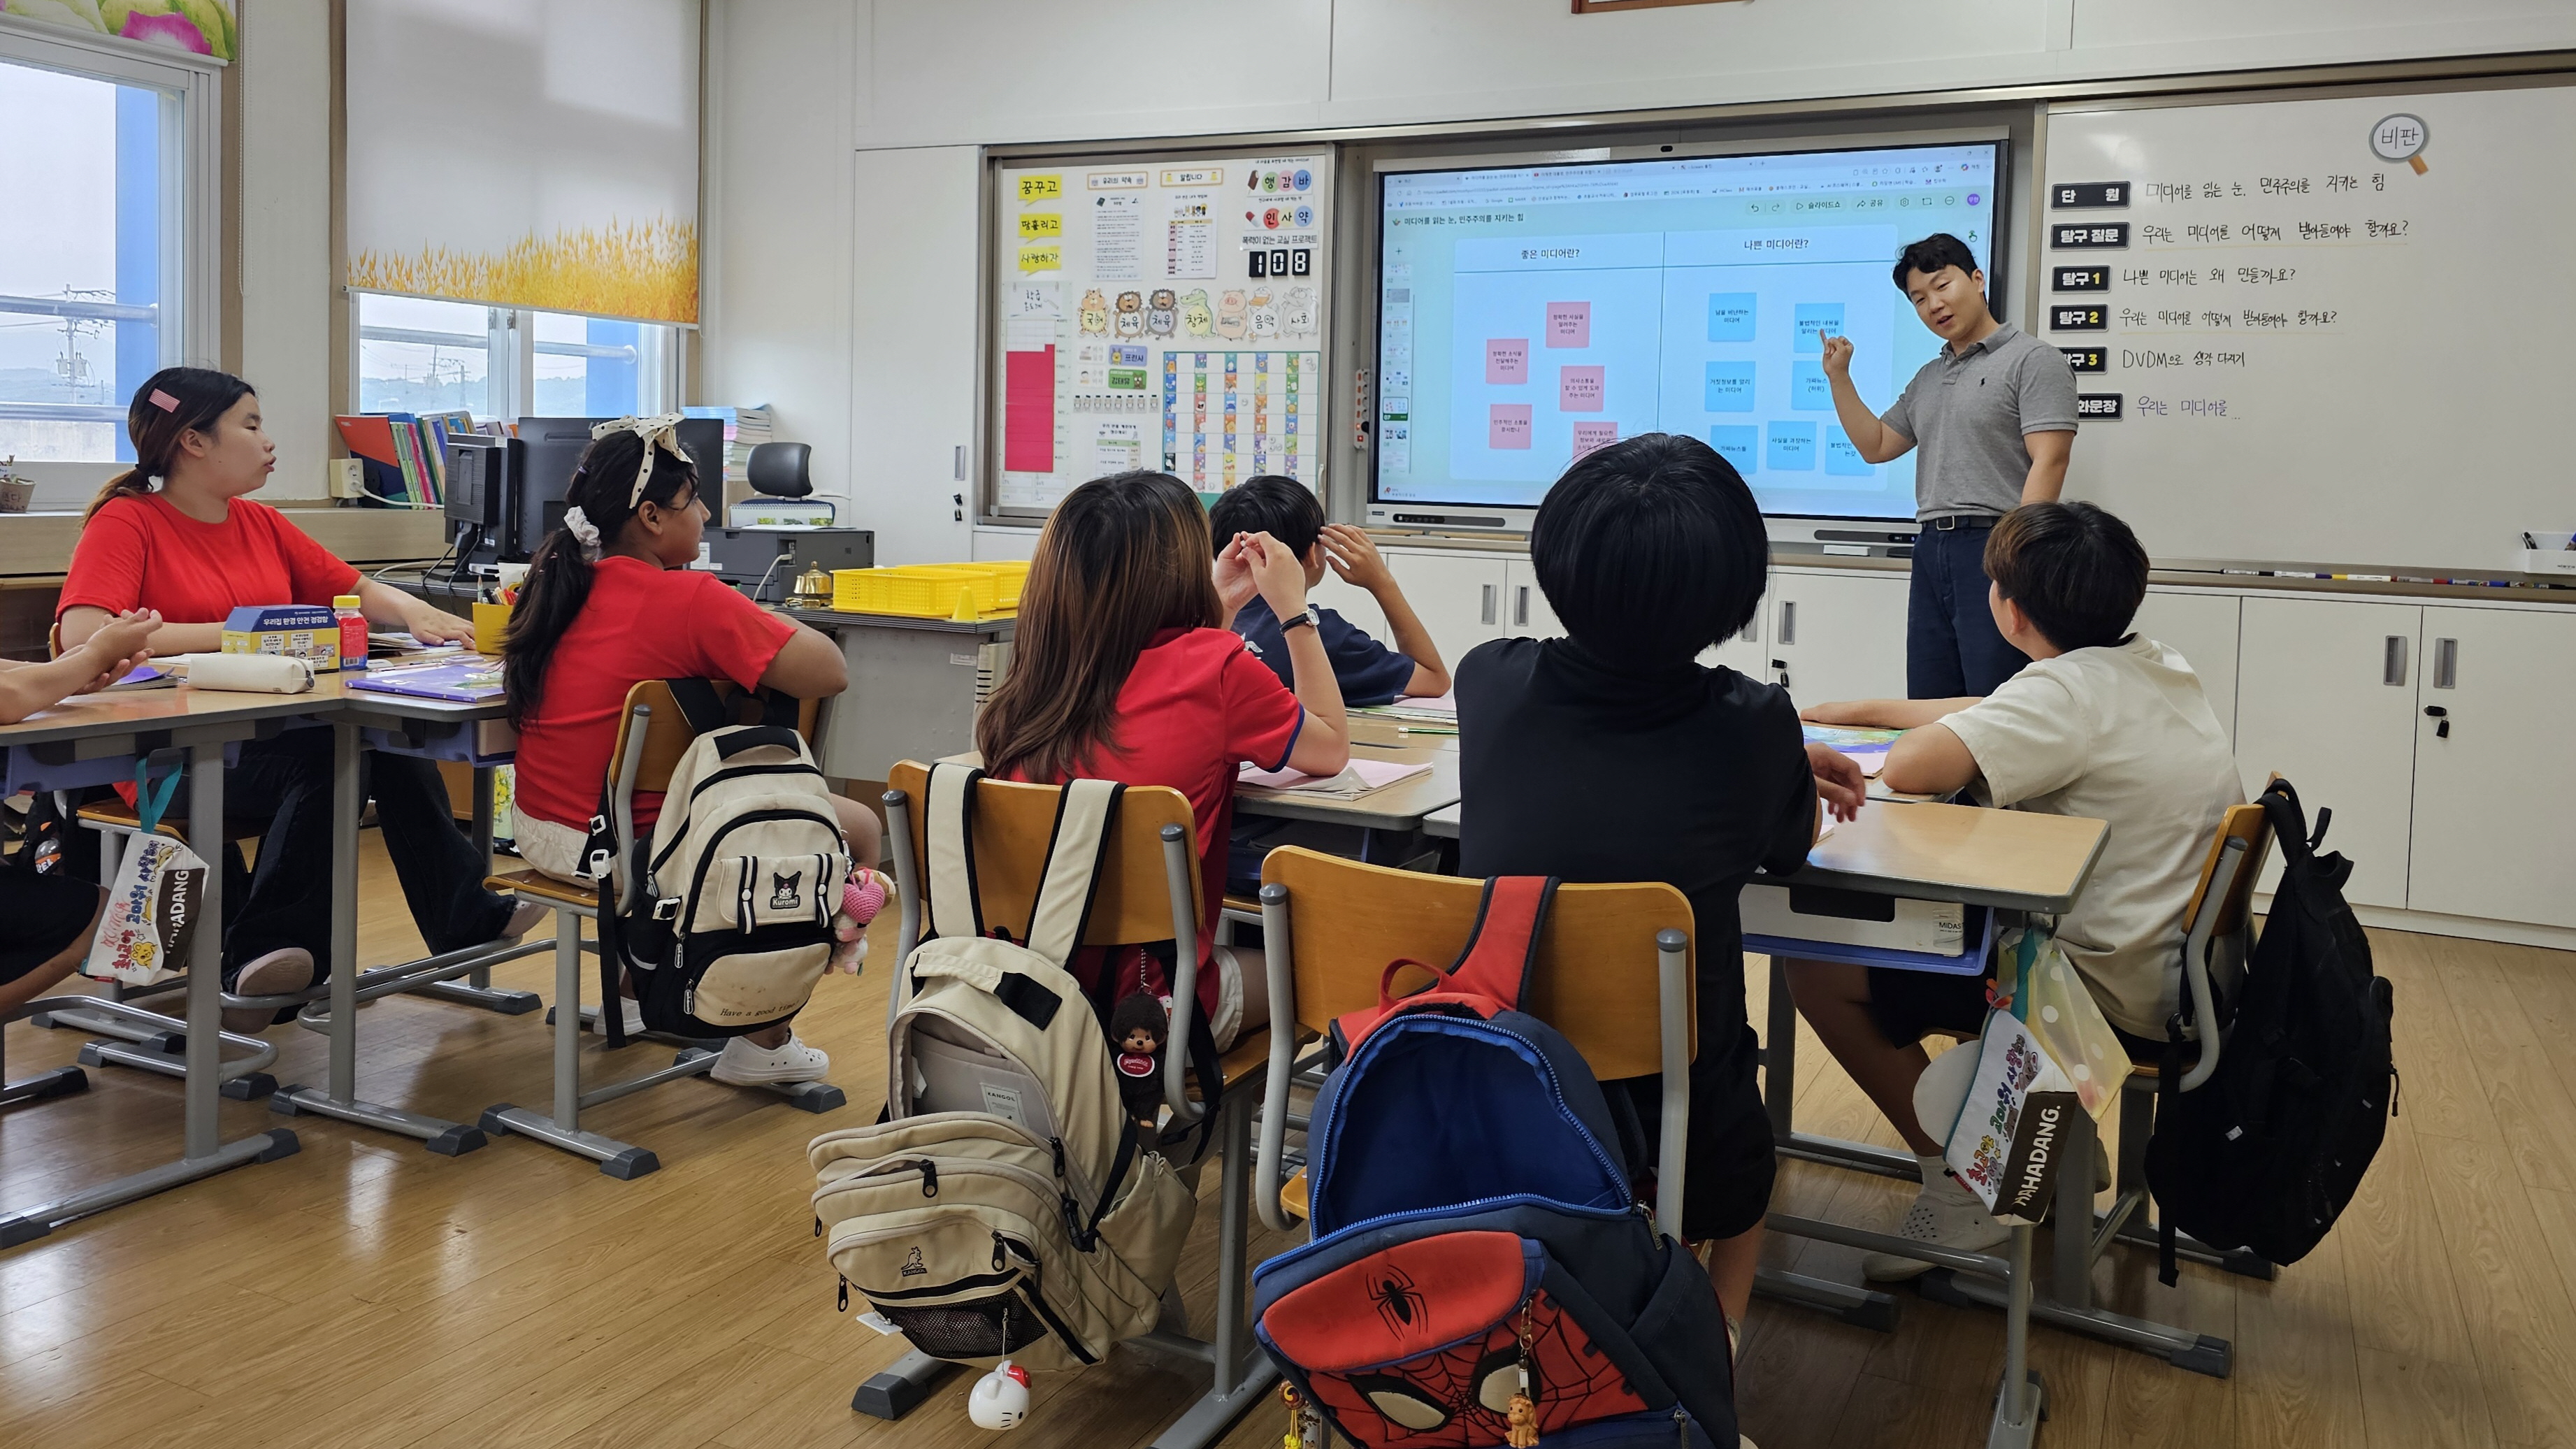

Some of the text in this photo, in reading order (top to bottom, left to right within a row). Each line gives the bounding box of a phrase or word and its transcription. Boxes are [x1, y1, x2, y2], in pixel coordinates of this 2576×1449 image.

[2382, 126, 2419, 150] 비판
[1103, 176, 1118, 185] 우리의
[1180, 173, 1202, 182] 알립니다
[1264, 174, 1309, 194] 행감바
[1022, 181, 1058, 194] 꿈꾸고
[2146, 182, 2192, 203] 미디어를
[2203, 181, 2222, 199] 읽는
[2260, 178, 2310, 196] 민주주의를
[2326, 174, 2359, 193] 지키는
[2372, 173, 2384, 192] 힘
[2061, 188, 2120, 203] 단 원
[1808, 201, 1841, 210] 슬라이드쇼
[1266, 211, 1309, 226] 인사약
[1404, 213, 1524, 225] 미디어를 읽는 눈, 민주주의를 지키는 힘
[2061, 229, 2119, 243] 탐구 질문
[2143, 225, 2175, 245] 우리는
[2187, 224, 2231, 243] 미디어를
[2242, 223, 2281, 241] 어떻게
[2365, 219, 2409, 238] 할까요?
[1242, 235, 1318, 245] 폭력이 없는 교실 프로젝트
[1744, 238, 1808, 250] 나쁜 미디어란?
[1021, 253, 1058, 264] 사랑하자
[1521, 248, 1580, 259] 좋은 미디어란?
[1258, 252, 1306, 274] 108
[2062, 272, 2100, 286] 탐구 1
[2123, 267, 2296, 286] 나쁜 미디어는 왜 만들까요?
[1120, 315, 1139, 329] 체육
[1152, 315, 1171, 328] 체육
[1186, 314, 1208, 328] 창체
[1255, 315, 1274, 329] 음악
[1290, 312, 1309, 324] 사회
[2059, 311, 2099, 325] 탐구 2
[2119, 308, 2147, 328] 우리는
[2158, 310, 2192, 326] 미디어를
[2201, 310, 2231, 327] 어떻게
[2298, 310, 2337, 326] 할까요?
[2088, 353, 2097, 366] 3
[2122, 349, 2184, 368] DVDM으로
[2136, 396, 2168, 417] 우리는
[138, 839, 160, 882] 사랑해
[126, 884, 148, 925] 고마워
[772, 896, 798, 907] Kuromi
[112, 929, 136, 969] 최고야
[720, 1008, 742, 1017] Have
[754, 1007, 776, 1017] good
[2006, 1034, 2025, 1085] 사랑해
[987, 1092, 1016, 1102] KANGOL
[1989, 1082, 2012, 1134] 고마워
[1966, 1134, 1994, 1186] 최고야
